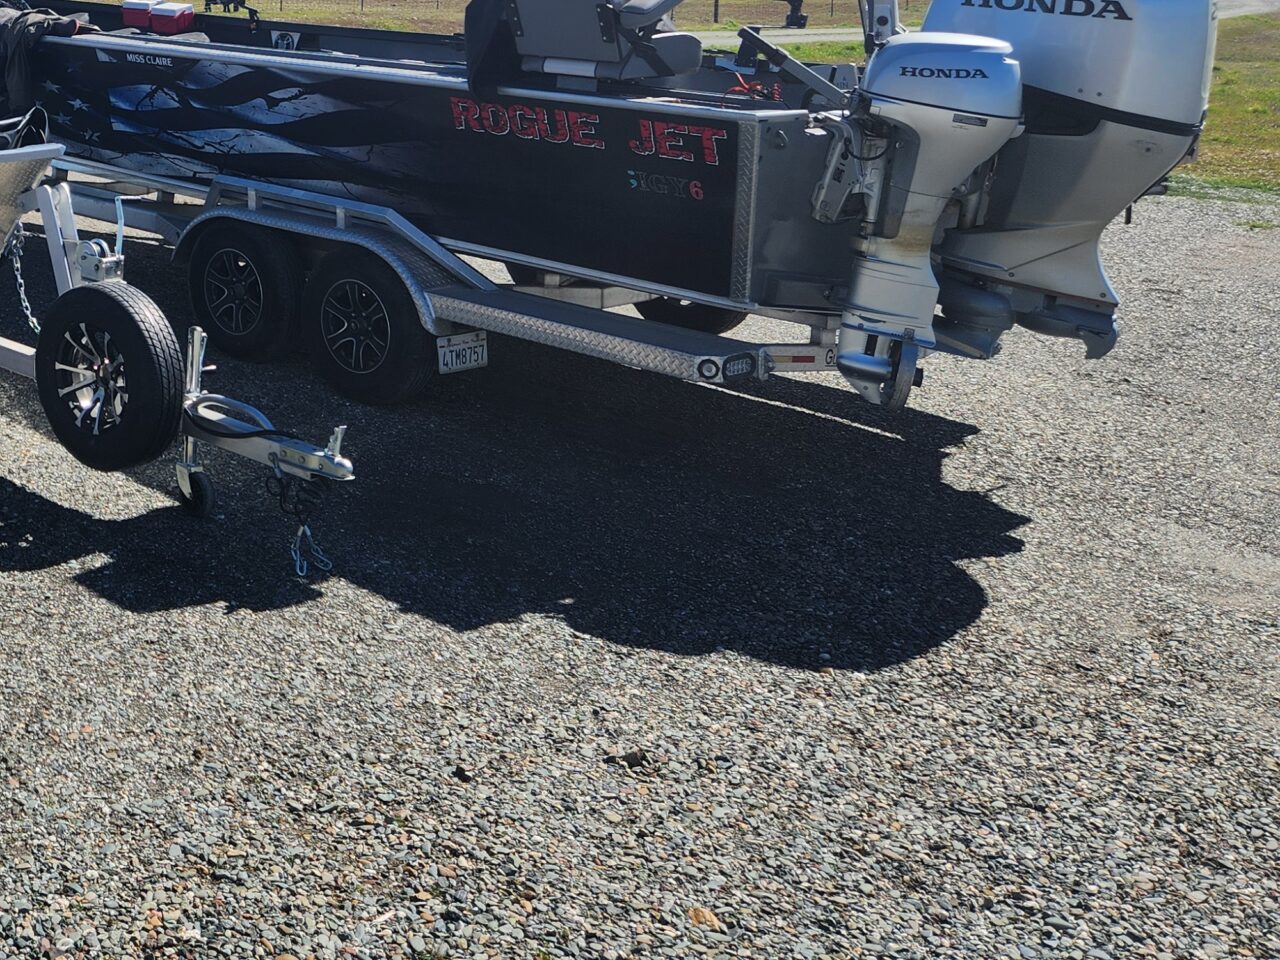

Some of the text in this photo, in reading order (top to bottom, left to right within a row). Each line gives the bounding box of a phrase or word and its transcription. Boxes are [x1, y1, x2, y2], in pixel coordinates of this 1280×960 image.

[127, 53, 174, 67] MISS CLAIRE
[900, 66, 989, 79] HONDA
[450, 96, 727, 166] ROGUE JET
[442, 344, 485, 368] 4TM8757
